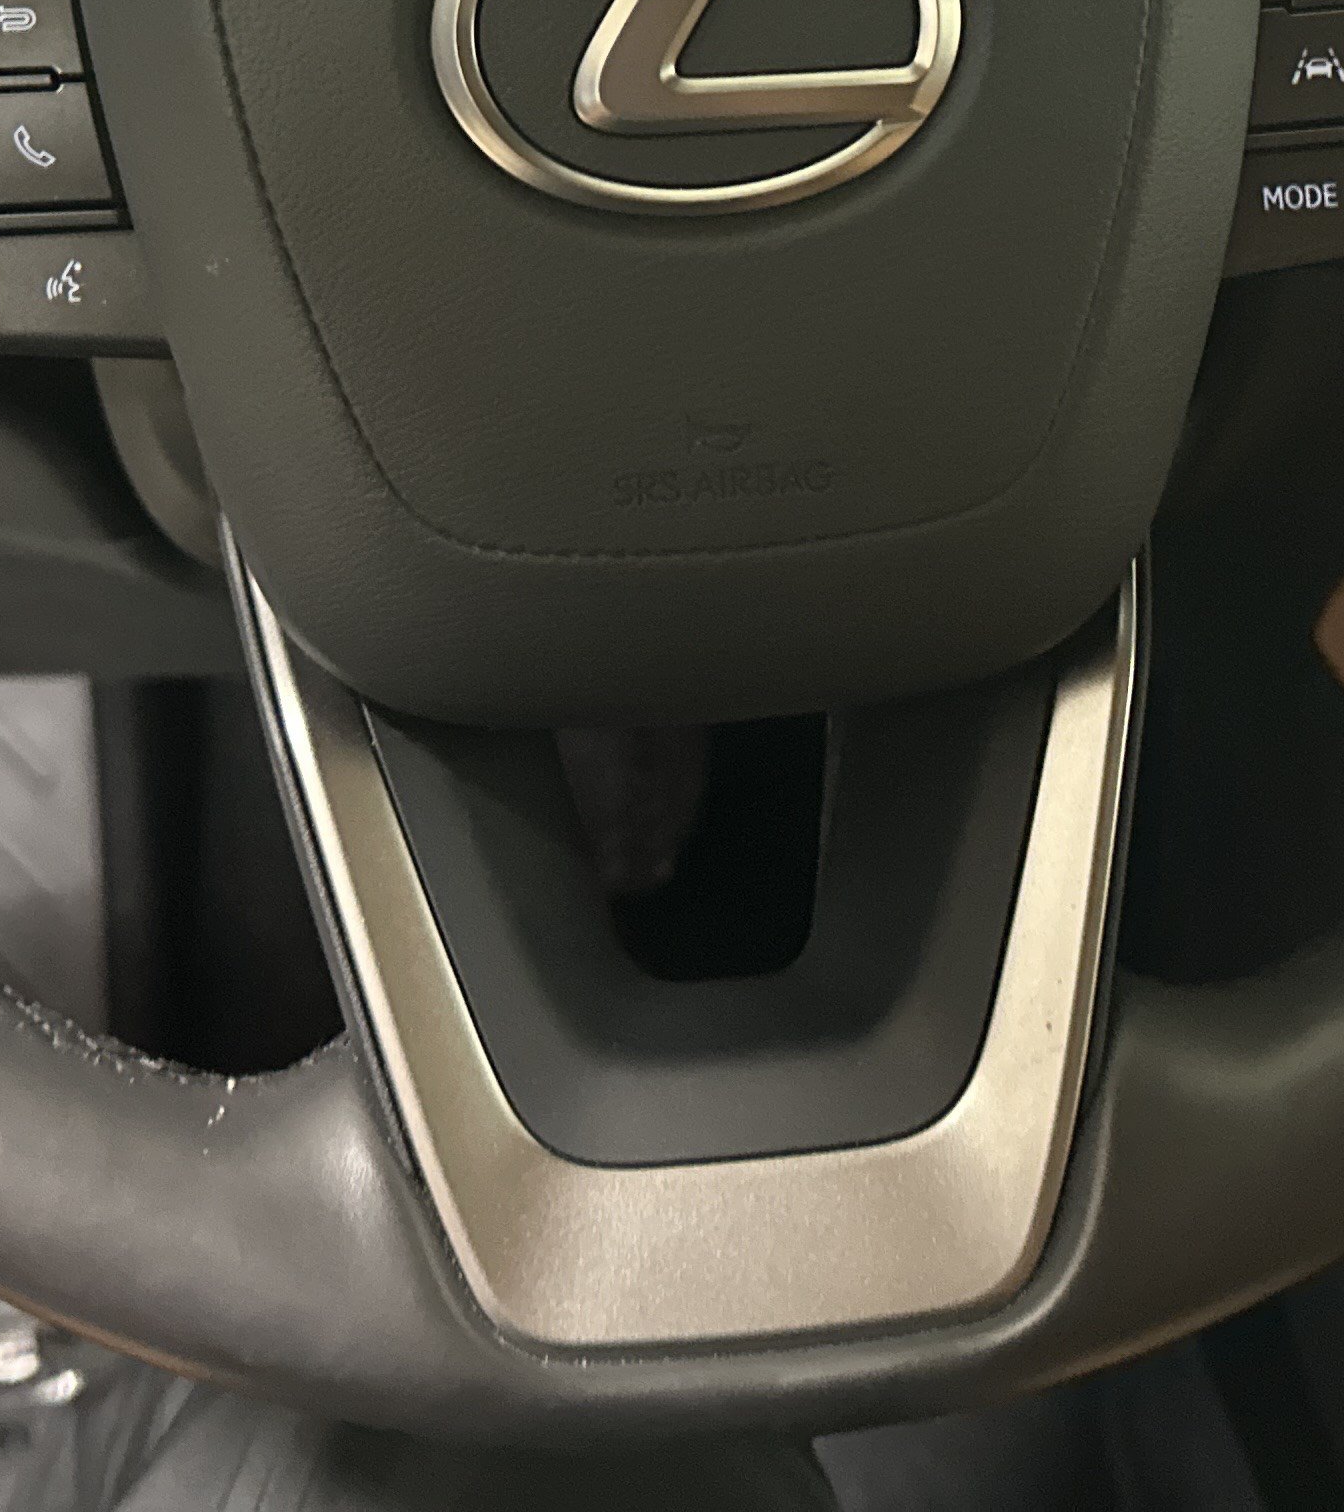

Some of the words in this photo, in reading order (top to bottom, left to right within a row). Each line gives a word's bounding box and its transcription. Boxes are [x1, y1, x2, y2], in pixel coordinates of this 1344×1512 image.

[1262, 181, 1339, 212] MODE
[612, 467, 682, 507] SRS
[689, 458, 834, 502] AIRBAG
